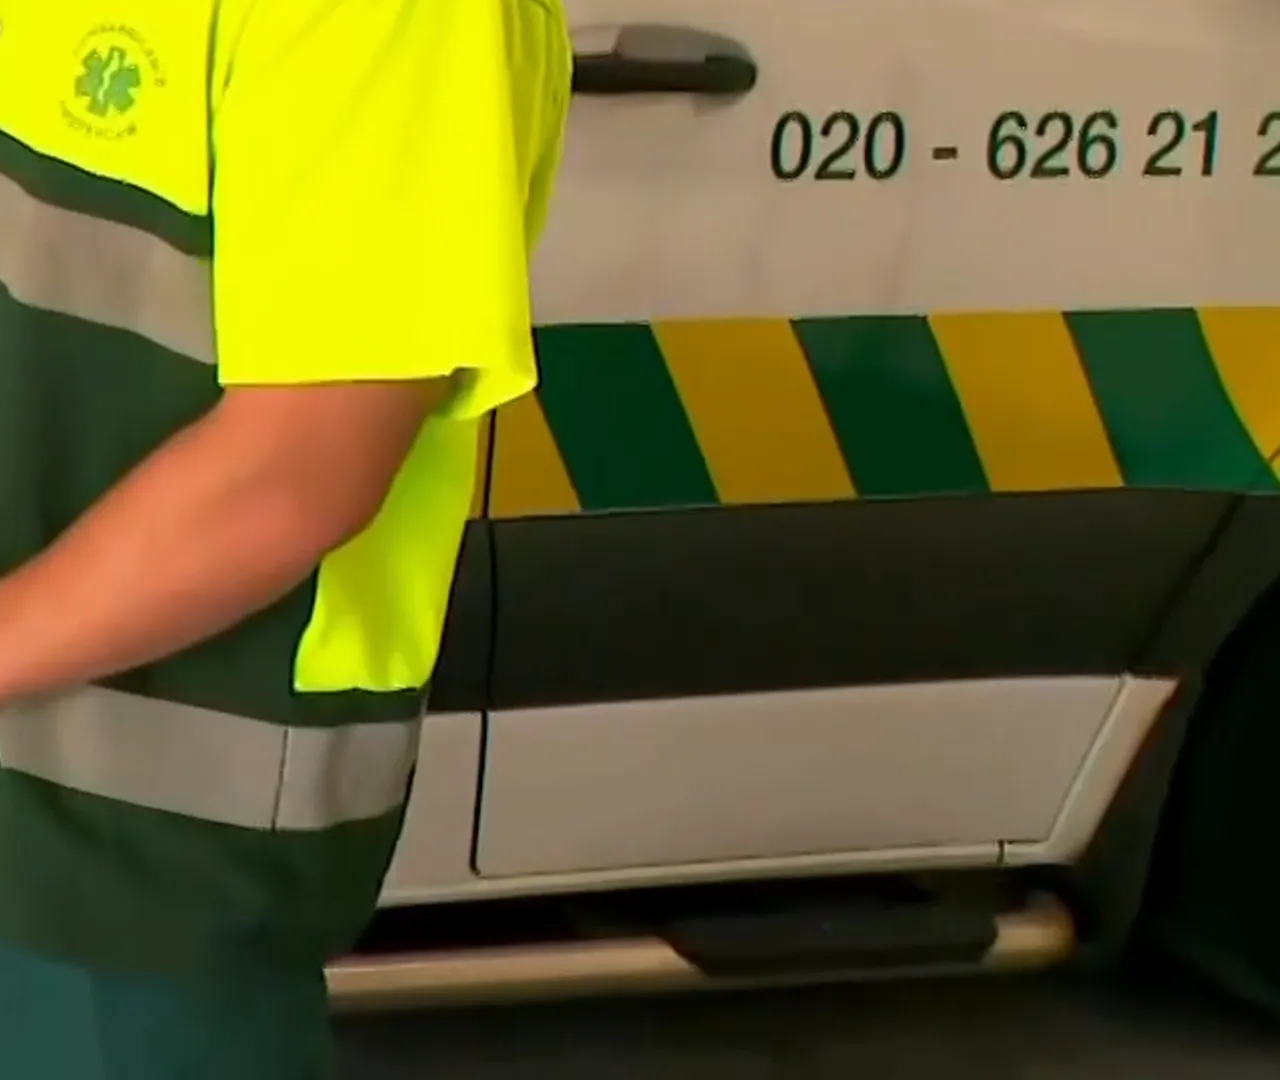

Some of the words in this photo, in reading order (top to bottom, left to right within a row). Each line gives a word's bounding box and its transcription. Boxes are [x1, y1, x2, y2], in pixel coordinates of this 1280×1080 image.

[770, 110, 907, 181] 020
[987, 110, 1119, 180] 626
[1143, 110, 1219, 178] 21
